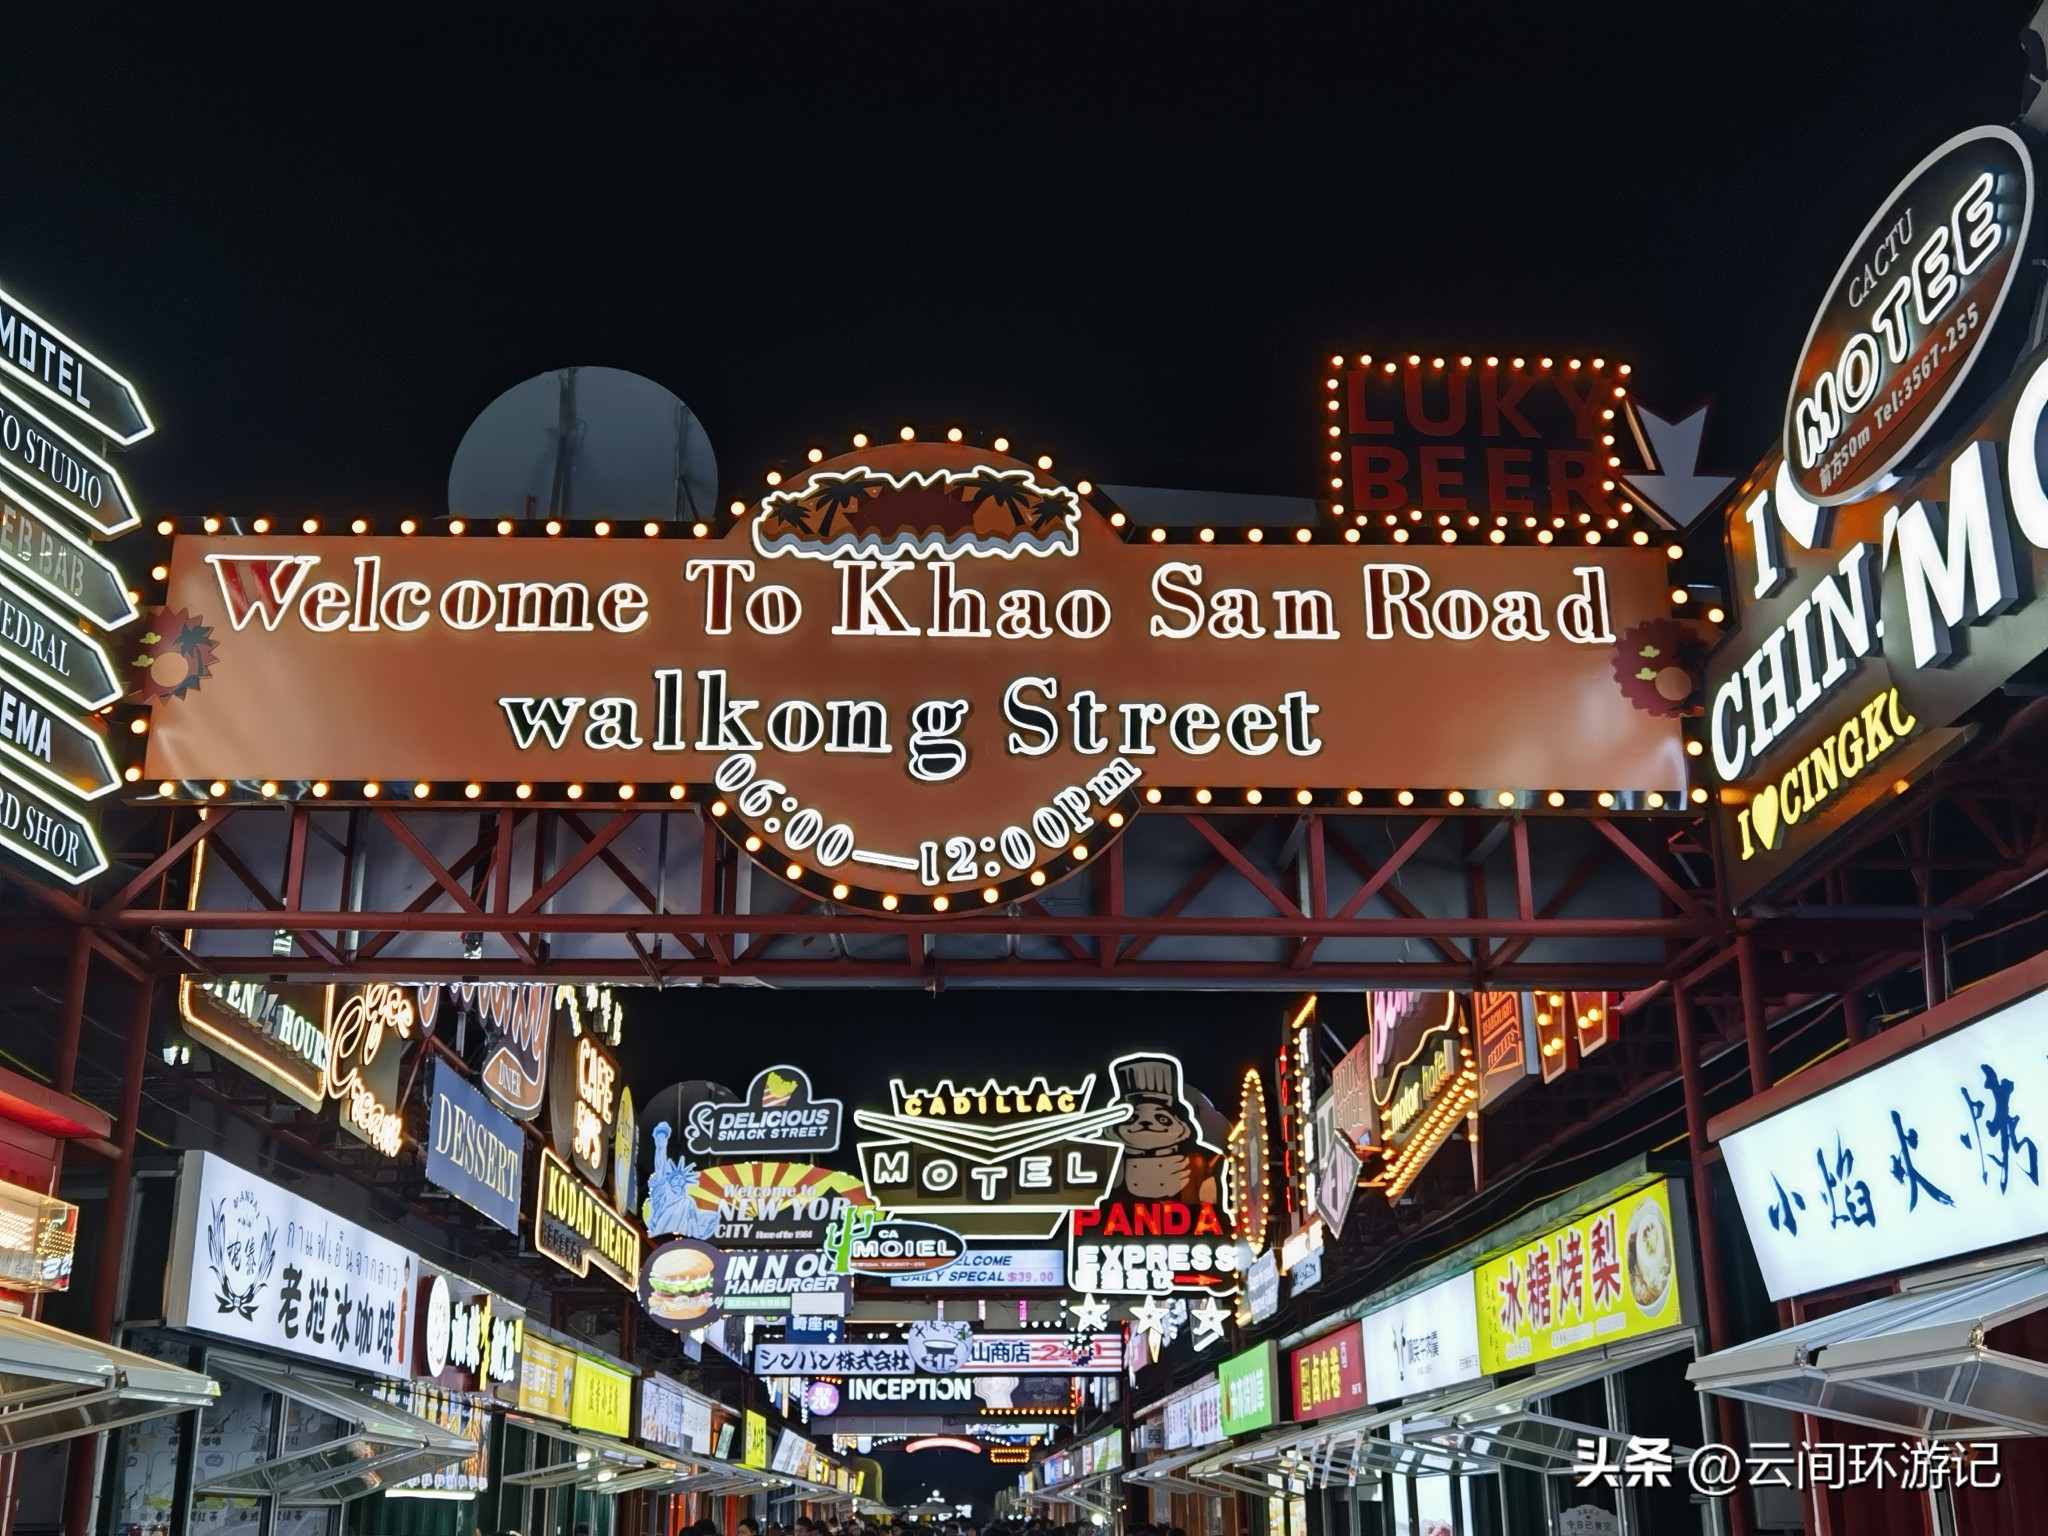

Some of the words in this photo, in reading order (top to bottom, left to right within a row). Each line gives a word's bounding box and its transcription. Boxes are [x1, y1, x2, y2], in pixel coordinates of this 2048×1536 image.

[1848, 207, 1914, 308] CACTU
[1347, 369, 1614, 441] LUKY
[1818, 425, 1871, 494] 前方50m
[1874, 302, 1979, 430] Tel:3567-255
[24, 428, 102, 509] STUDIO
[1349, 446, 1617, 516] BEER
[205, 553, 649, 633] Welcome
[685, 559, 803, 636] To
[831, 559, 1112, 640] Khao
[1150, 562, 1341, 641] San
[1363, 563, 1617, 645] Road
[1711, 540, 1885, 781] CHIN
[499, 668, 970, 782] walkong
[1003, 676, 1323, 758] Street
[23, 805, 80, 868] SHOR
[718, 1109, 831, 1130] DELICIOUS
[905, 1093, 1076, 1117] CADILLAC
[1391, 1082, 1420, 1134] motor
[435, 1092, 519, 1204] DESSERT
[717, 1127, 767, 1142] SNACK
[770, 1126, 829, 1139] STREET
[723, 1184, 797, 1198] Welcome
[800, 1184, 817, 1196] to
[873, 1151, 1098, 1201] MOTEL
[713, 1223, 754, 1240] CITY
[717, 1197, 783, 1222] NEW
[878, 1230, 899, 1239] CA
[1073, 1201, 1224, 1237] PANDA
[724, 1255, 758, 1281] IN
[763, 1254, 789, 1280] N
[949, 1271, 1005, 1282] SPECAL
[1006, 1271, 1054, 1283] $39.00
[1077, 1243, 1239, 1272] EXPRESS
[1499, 1211, 1622, 1337] 冰糖烤梨
[724, 1277, 840, 1295] HAMBURGER
[278, 1262, 396, 1366] 老挝冰咖啡
[848, 1377, 973, 1401] INCEPTION
